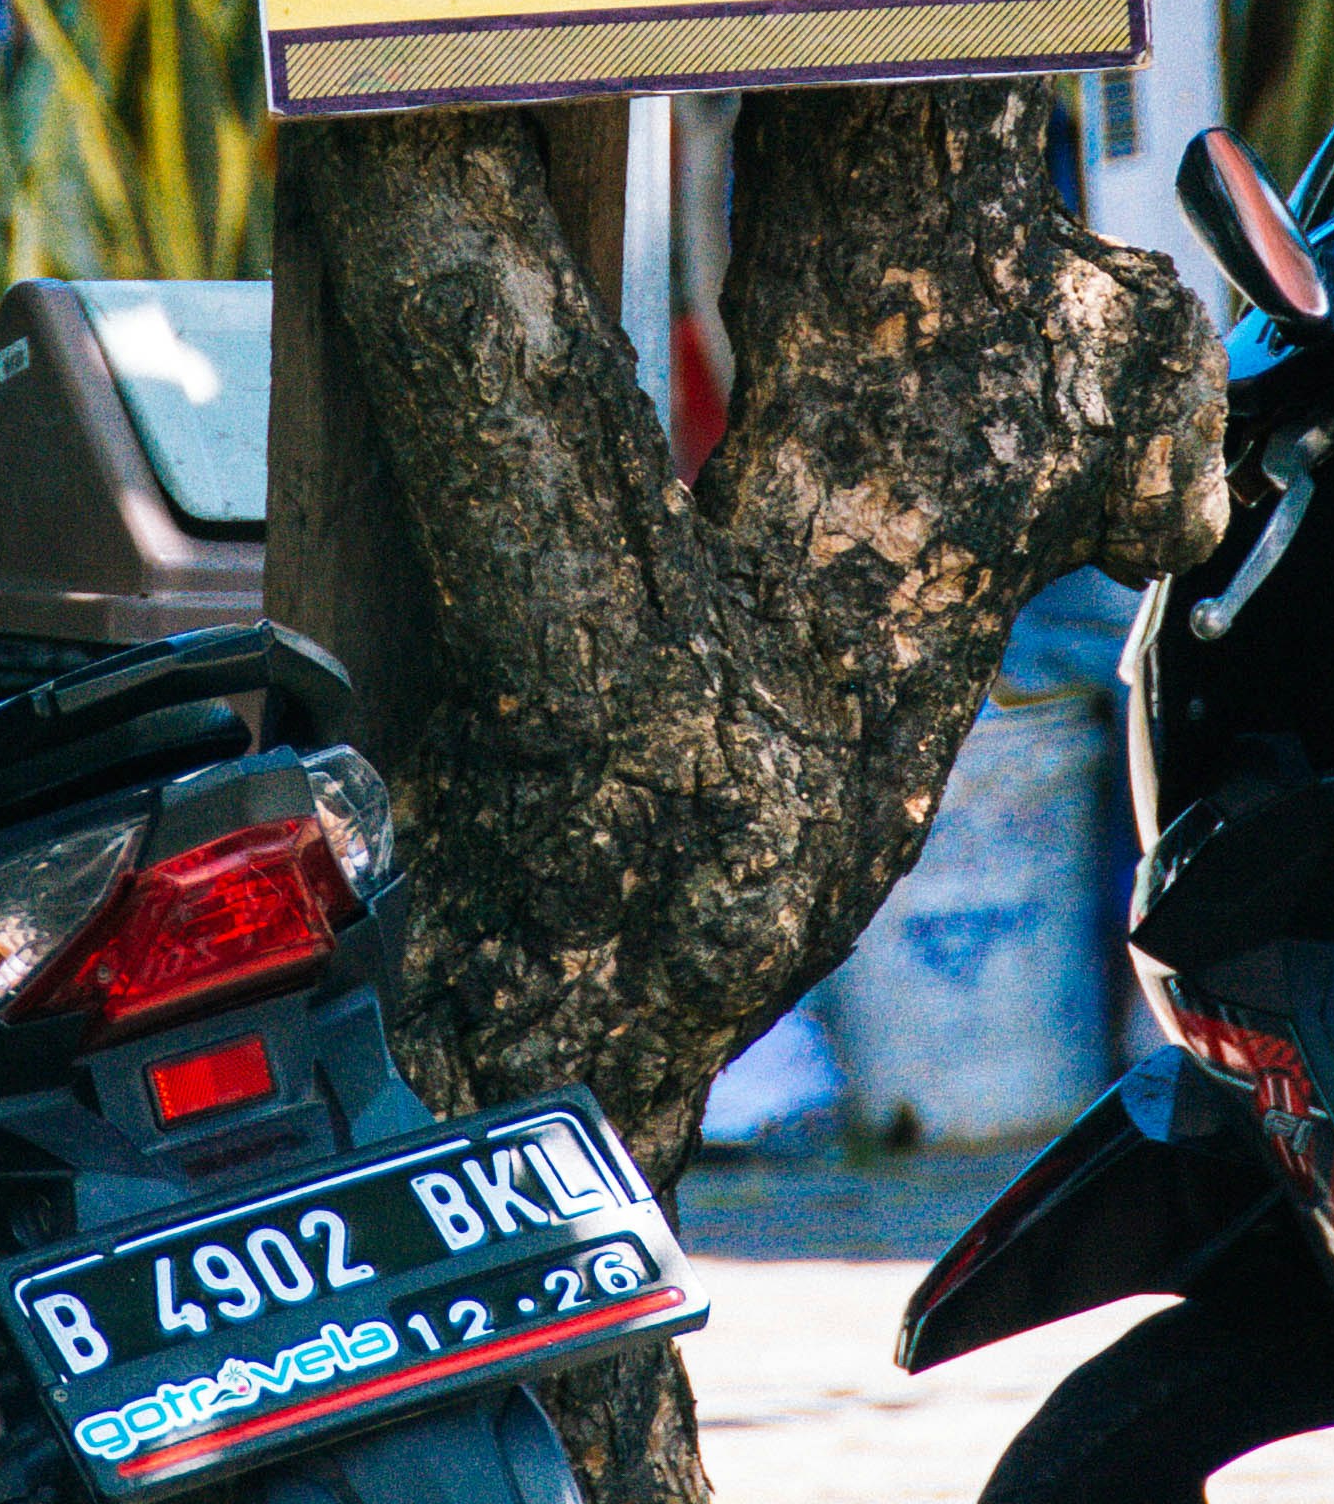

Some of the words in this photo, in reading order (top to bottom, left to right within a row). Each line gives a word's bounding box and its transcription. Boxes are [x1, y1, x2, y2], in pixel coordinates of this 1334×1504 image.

[33, 1292, 110, 1377] B
[156, 1209, 376, 1337] 4902
[410, 1142, 606, 1256] BKL
